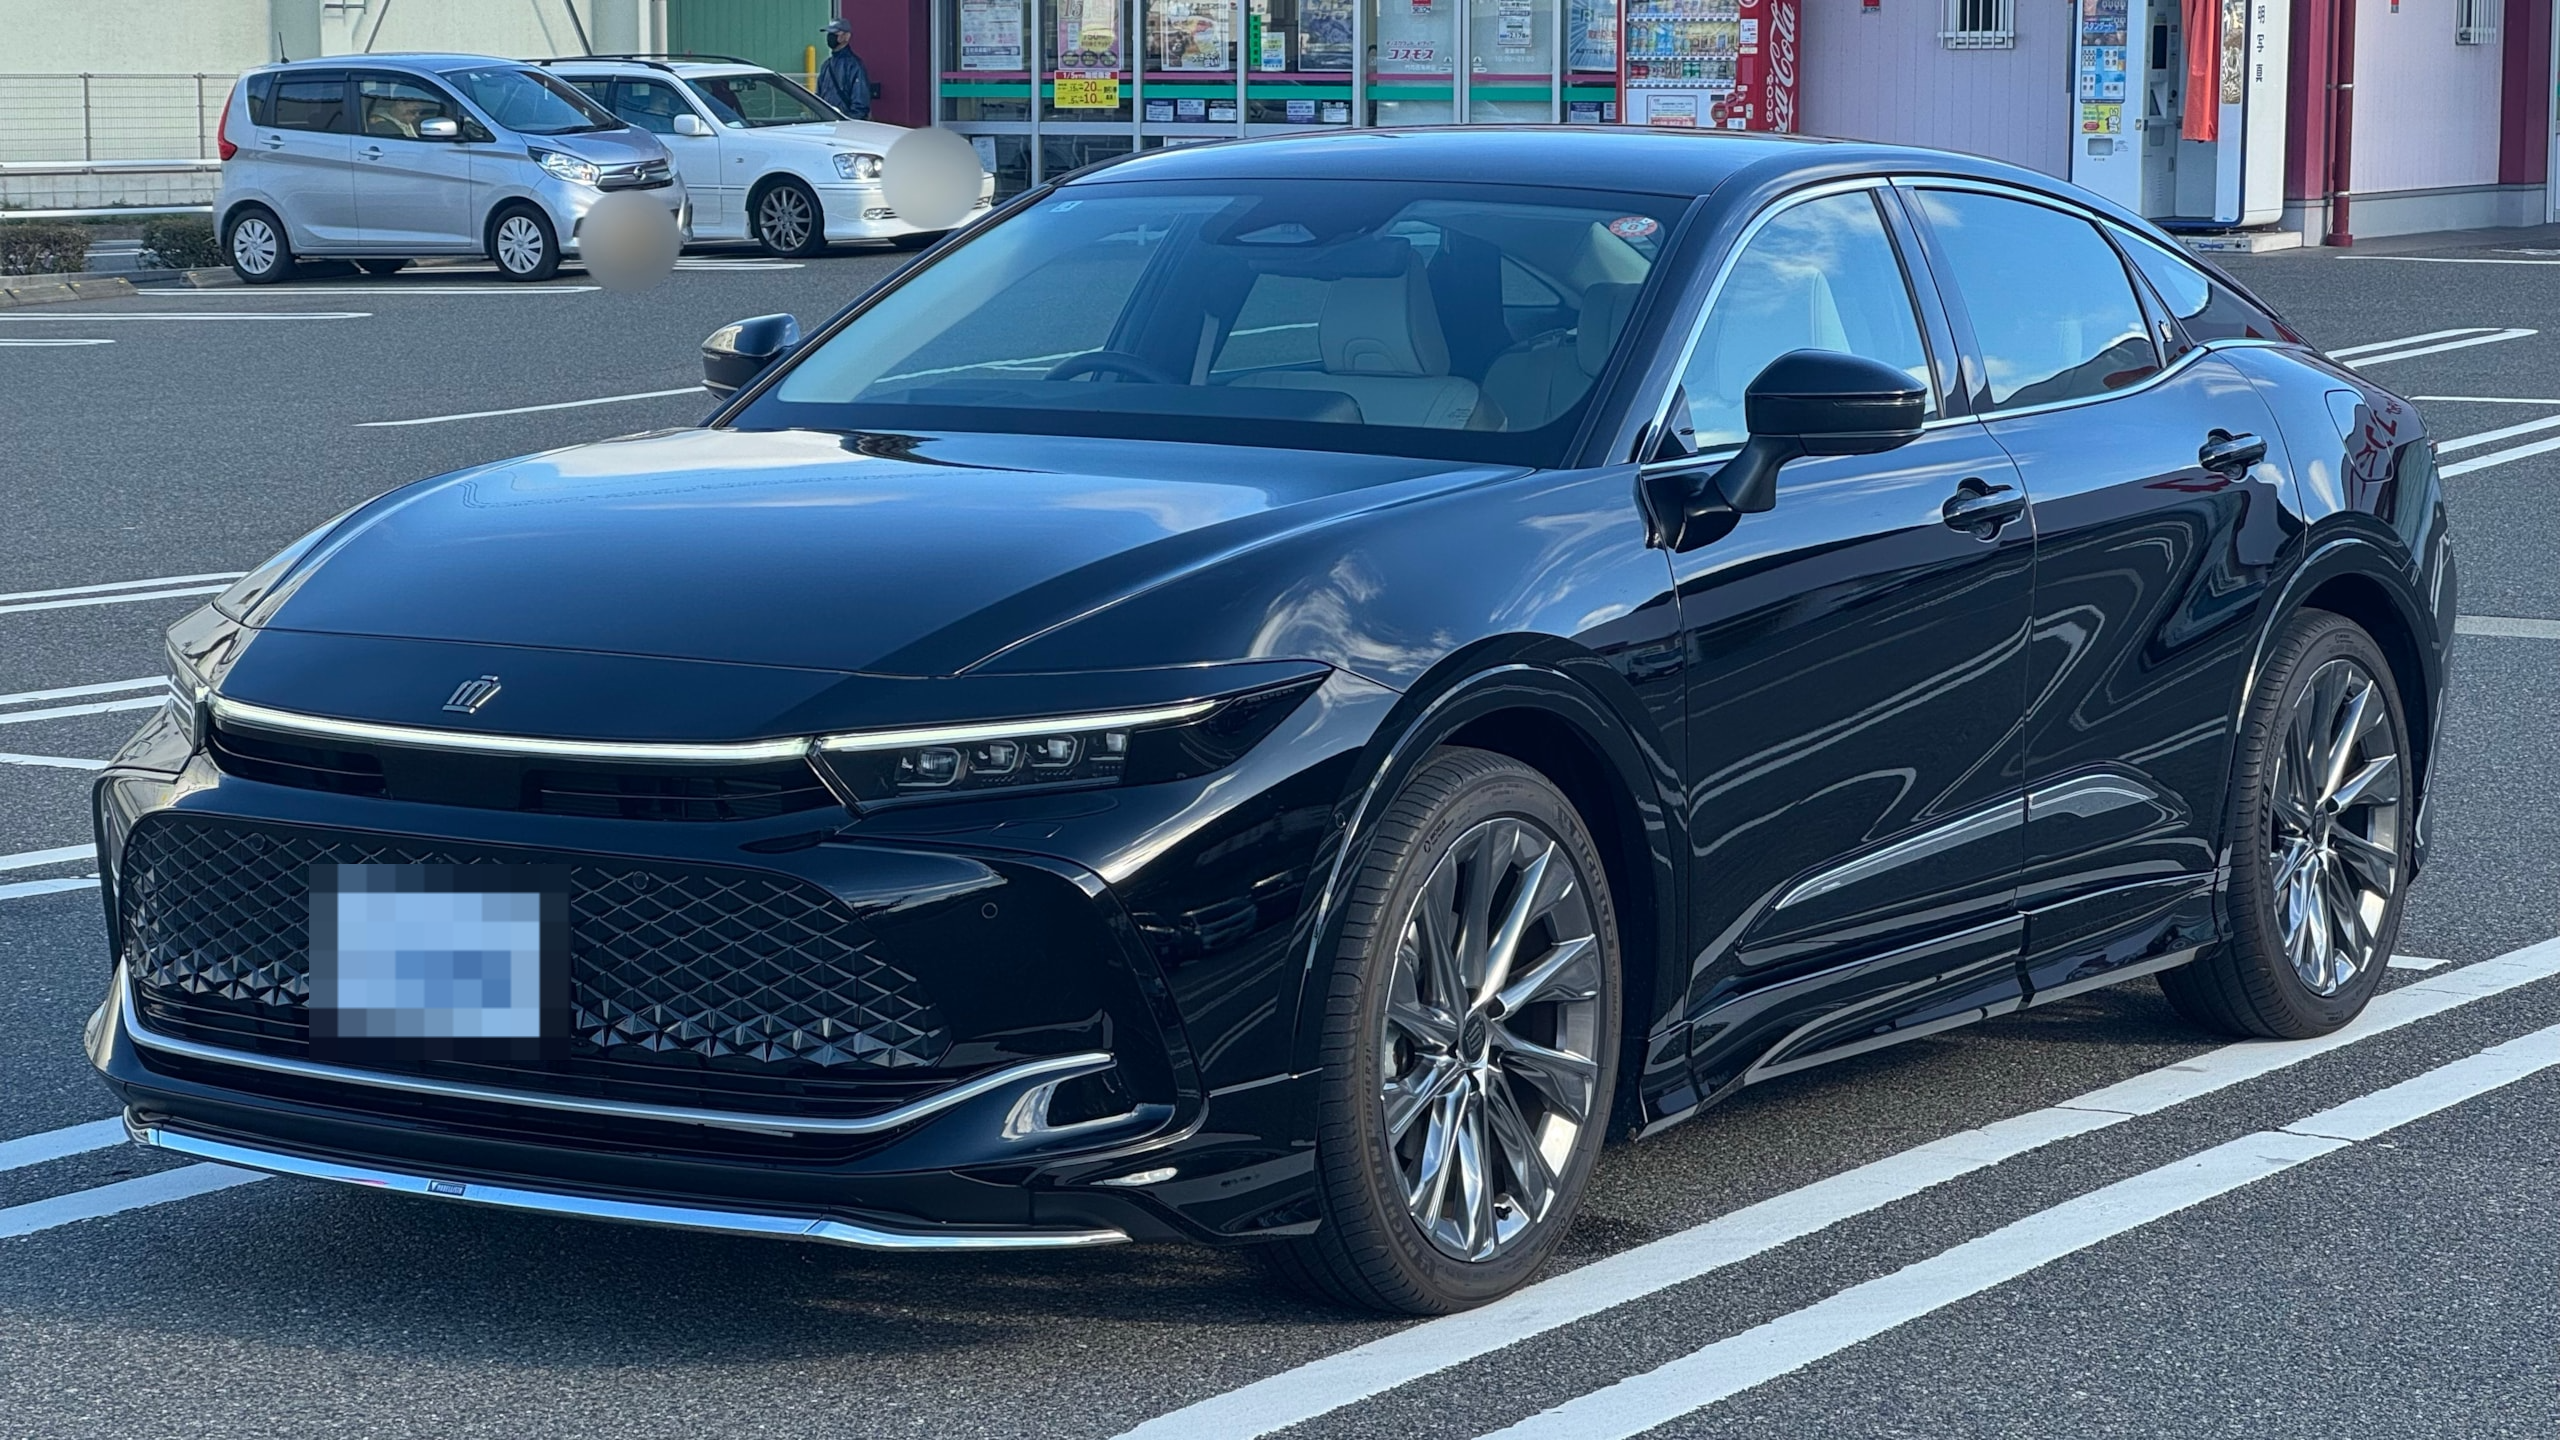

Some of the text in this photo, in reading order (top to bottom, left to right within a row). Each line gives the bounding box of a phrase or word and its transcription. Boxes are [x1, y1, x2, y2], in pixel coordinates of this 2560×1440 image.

[1387, 48, 1434, 60] コスモス
[1770, 0, 1795, 132] ca-Cola
[1084, 81, 1097, 92] 20
[1084, 93, 1097, 104] 10
[1572, 831, 1613, 942] MICHELIN
[1370, 1145, 1420, 1260] MICHELIN
